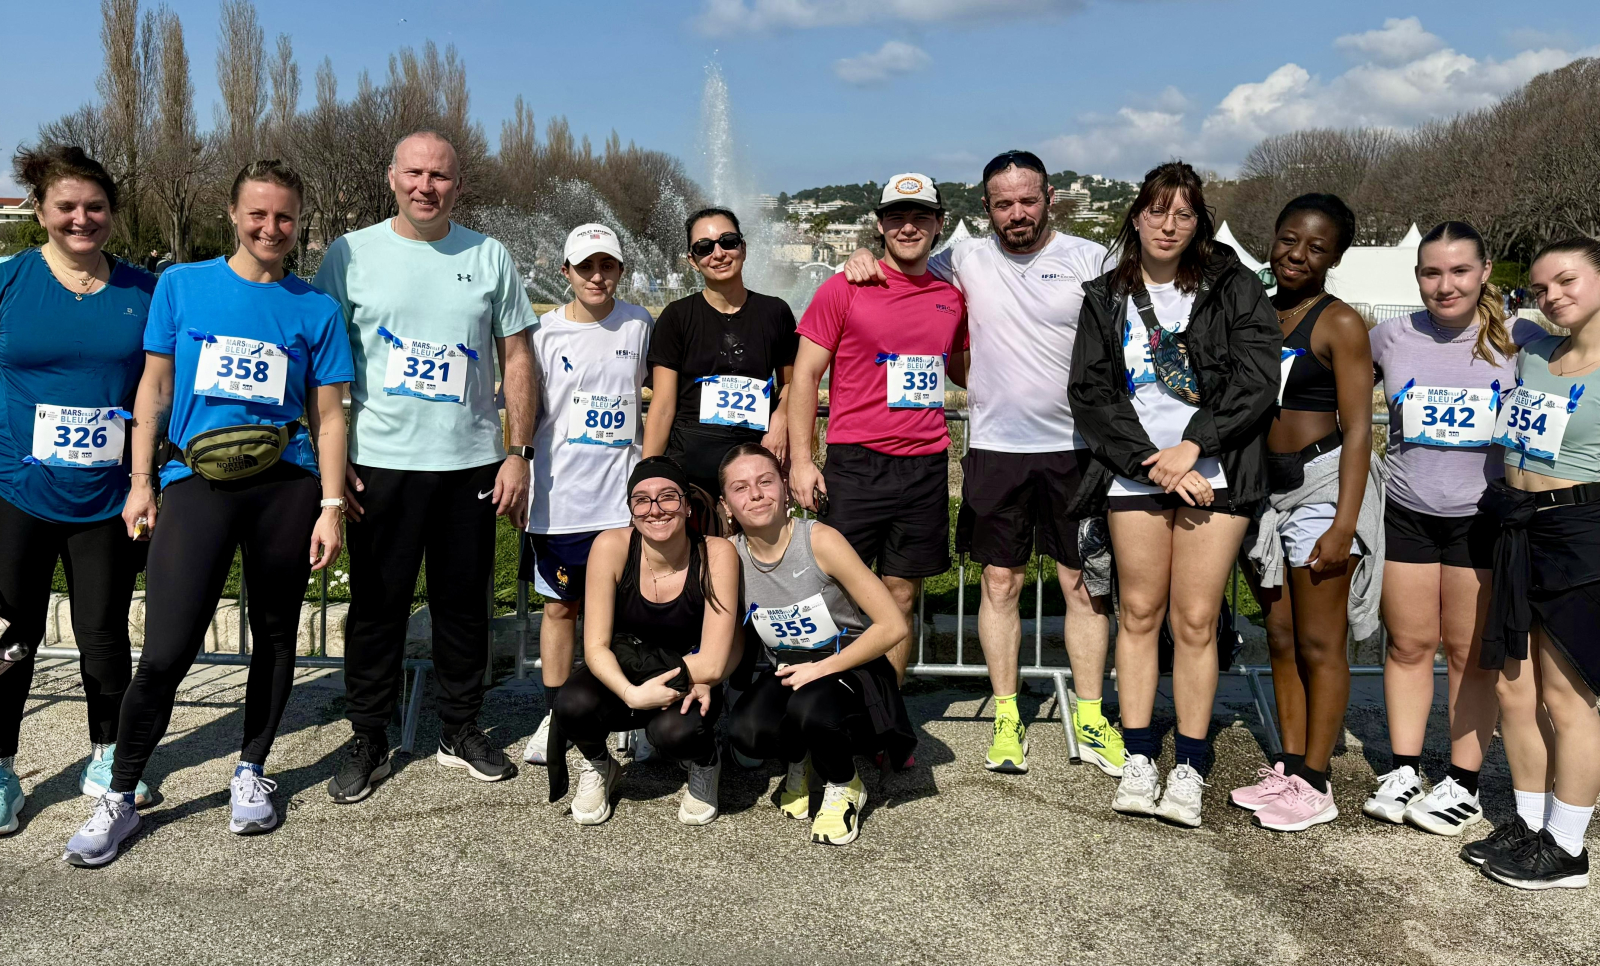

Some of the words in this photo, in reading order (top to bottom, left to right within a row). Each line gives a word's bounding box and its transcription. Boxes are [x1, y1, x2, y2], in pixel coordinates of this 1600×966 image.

[216, 355, 269, 383] 358
[403, 356, 450, 382] 321
[902, 371, 938, 391] 339
[716, 390, 757, 413] 322
[584, 409, 626, 430] 809
[1421, 405, 1475, 428] 342
[1506, 405, 1548, 436] 354
[53, 425, 108, 448] 326
[216, 460, 244, 469] NORTH
[223, 465, 245, 474] FACE
[226, 454, 244, 463] THE
[769, 616, 818, 638] 355
